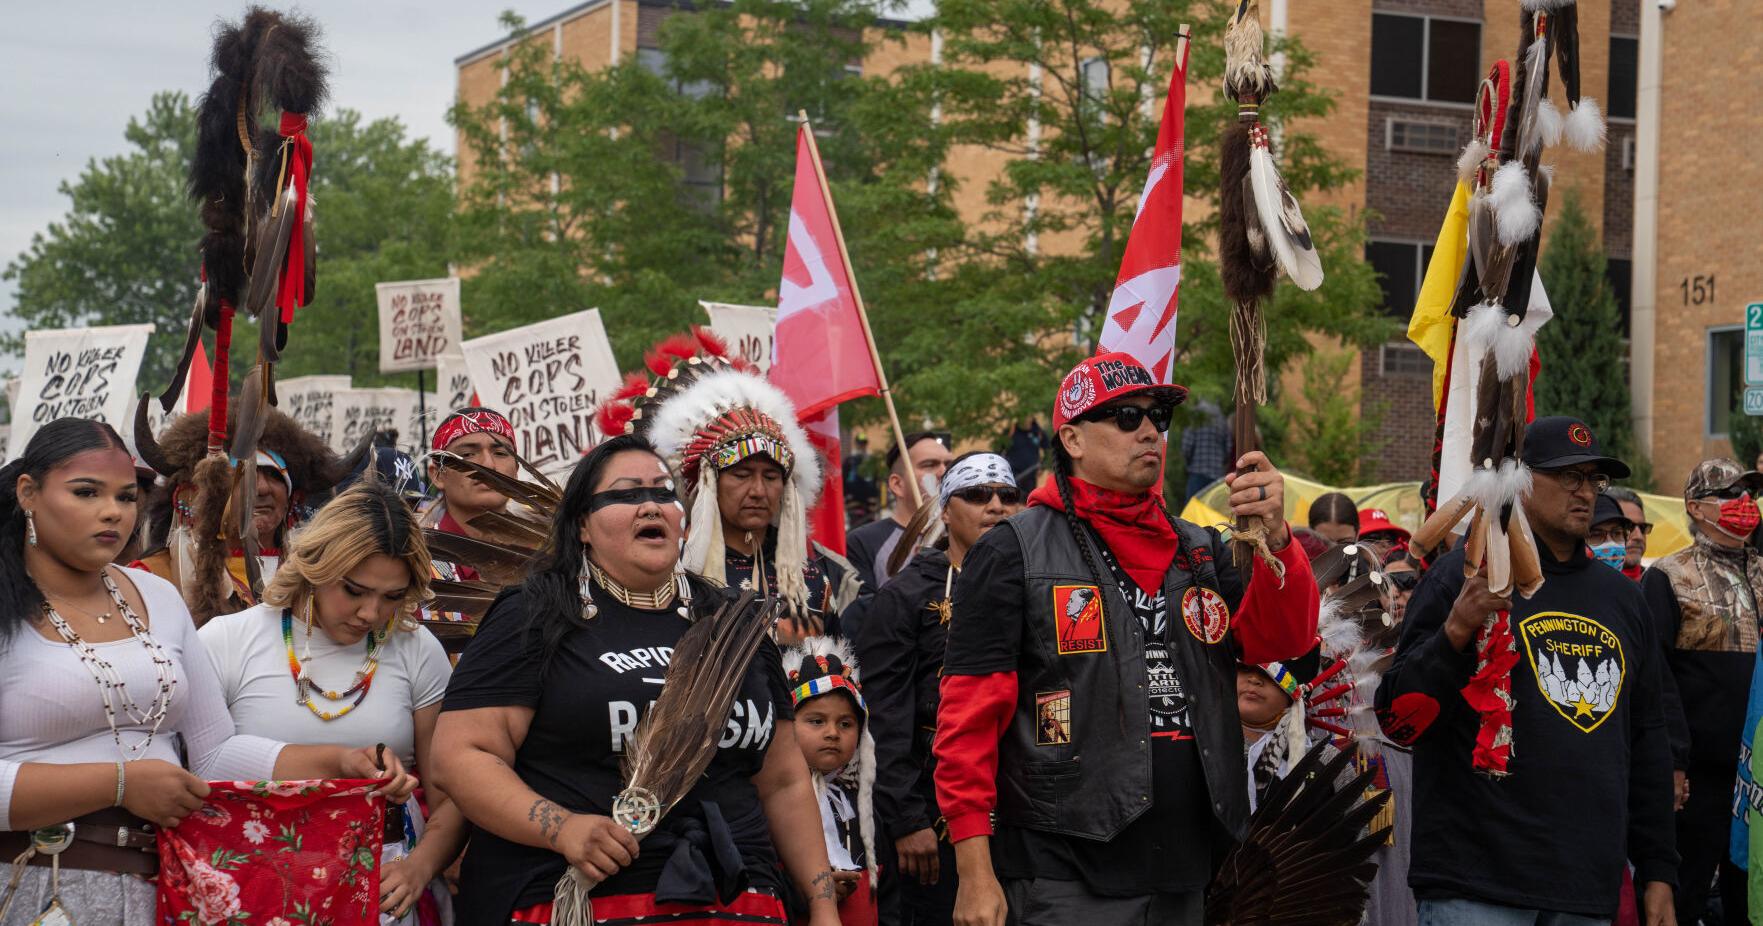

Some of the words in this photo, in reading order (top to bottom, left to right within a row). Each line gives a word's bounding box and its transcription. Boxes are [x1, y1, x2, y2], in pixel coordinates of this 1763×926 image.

[1680, 273, 1715, 306] 151
[392, 295, 407, 310] NO
[393, 304, 442, 324] COPS
[394, 335, 447, 360] LAND
[740, 334, 762, 362] NO
[45, 351, 71, 376] NO
[491, 351, 520, 381] NO
[1094, 360, 1124, 377] The
[40, 362, 117, 400] COPS
[450, 374, 469, 391] NO
[503, 353, 585, 406] COPS
[33, 402, 63, 422] ON
[509, 401, 535, 428] ON
[1060, 639, 1104, 651] RESIST
[1527, 618, 1597, 638] PENNINGTON
[1600, 631, 1616, 649] CO
[1546, 638, 1603, 657] SHERIFF
